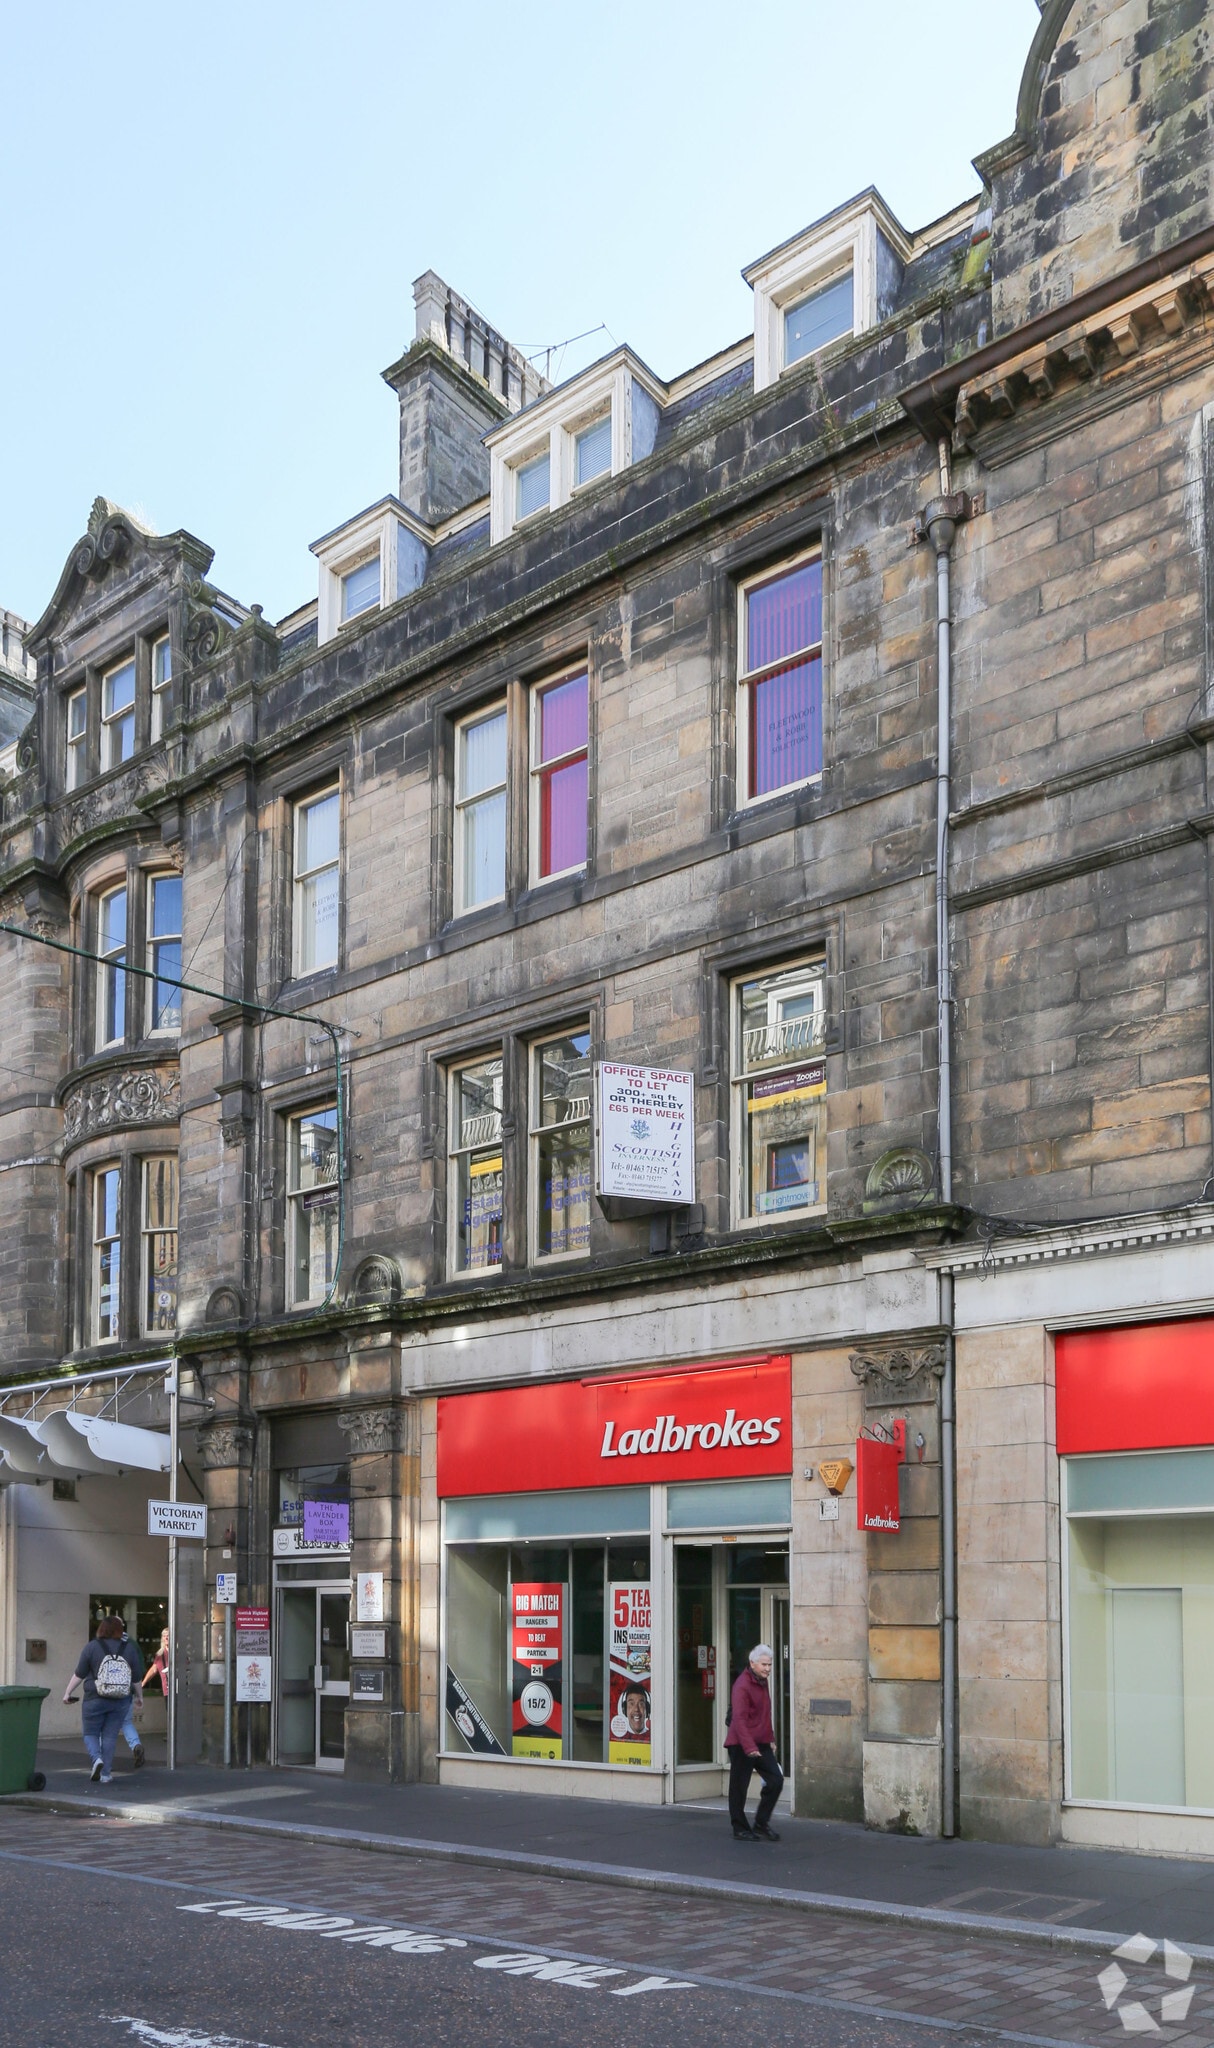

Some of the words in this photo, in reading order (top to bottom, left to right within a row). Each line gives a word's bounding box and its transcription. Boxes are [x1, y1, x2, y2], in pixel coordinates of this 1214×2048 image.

[768, 705, 816, 732] FLEETWOOD
[604, 1066, 646, 1078] OFFICE
[650, 1072, 690, 1084] SPACE
[796, 1070, 821, 1082] Zoopla
[628, 1079, 643, 1088] TO
[647, 1082, 668, 1091] LET
[617, 1088, 646, 1097] 300+
[668, 1094, 677, 1102] ft
[609, 1095, 626, 1103] OR
[630, 1097, 684, 1110] THEREBY
[609, 1104, 629, 1113] £65
[632, 1107, 652, 1116] PER
[655, 1110, 685, 1120] WEEK
[612, 1142, 682, 1159] SCOTTISH
[618, 1153, 666, 1163] INVERNESS
[626, 1164, 645, 1174] 01463
[647, 1165, 668, 1176] 715175
[546, 1172, 591, 1195] Estate
[772, 1192, 809, 1207] rightmove
[601, 1409, 782, 1457] Ladbrokes
[152, 1507, 203, 1519] VICTORIAN
[309, 1511, 345, 1519] LAVENDER
[159, 1520, 197, 1531] MARKET
[864, 1513, 899, 1529] Ladbrokes
[516, 1595, 529, 1611] BIG
[531, 1595, 559, 1611] MATCH
[614, 1590, 629, 1627] 5
[631, 1590, 650, 1607] TEA
[525, 1618, 548, 1626] RANGERS
[528, 1633, 535, 1643] TO
[535, 1633, 546, 1643] BEAT
[614, 1630, 627, 1644] INS
[629, 1633, 650, 1641] VACANCIES
[526, 1649, 547, 1657] PARTICK
[532, 1666, 542, 1674] 2-1
[528, 1698, 546, 1709] 15/2
[465, 1700, 481, 1723] SCOTTISH
[479, 1720, 494, 1745] FOOTBALL
[628, 1757, 641, 1765] FUN
[176, 1900, 468, 1953] LOADING
[473, 1954, 699, 1996] ONLY
